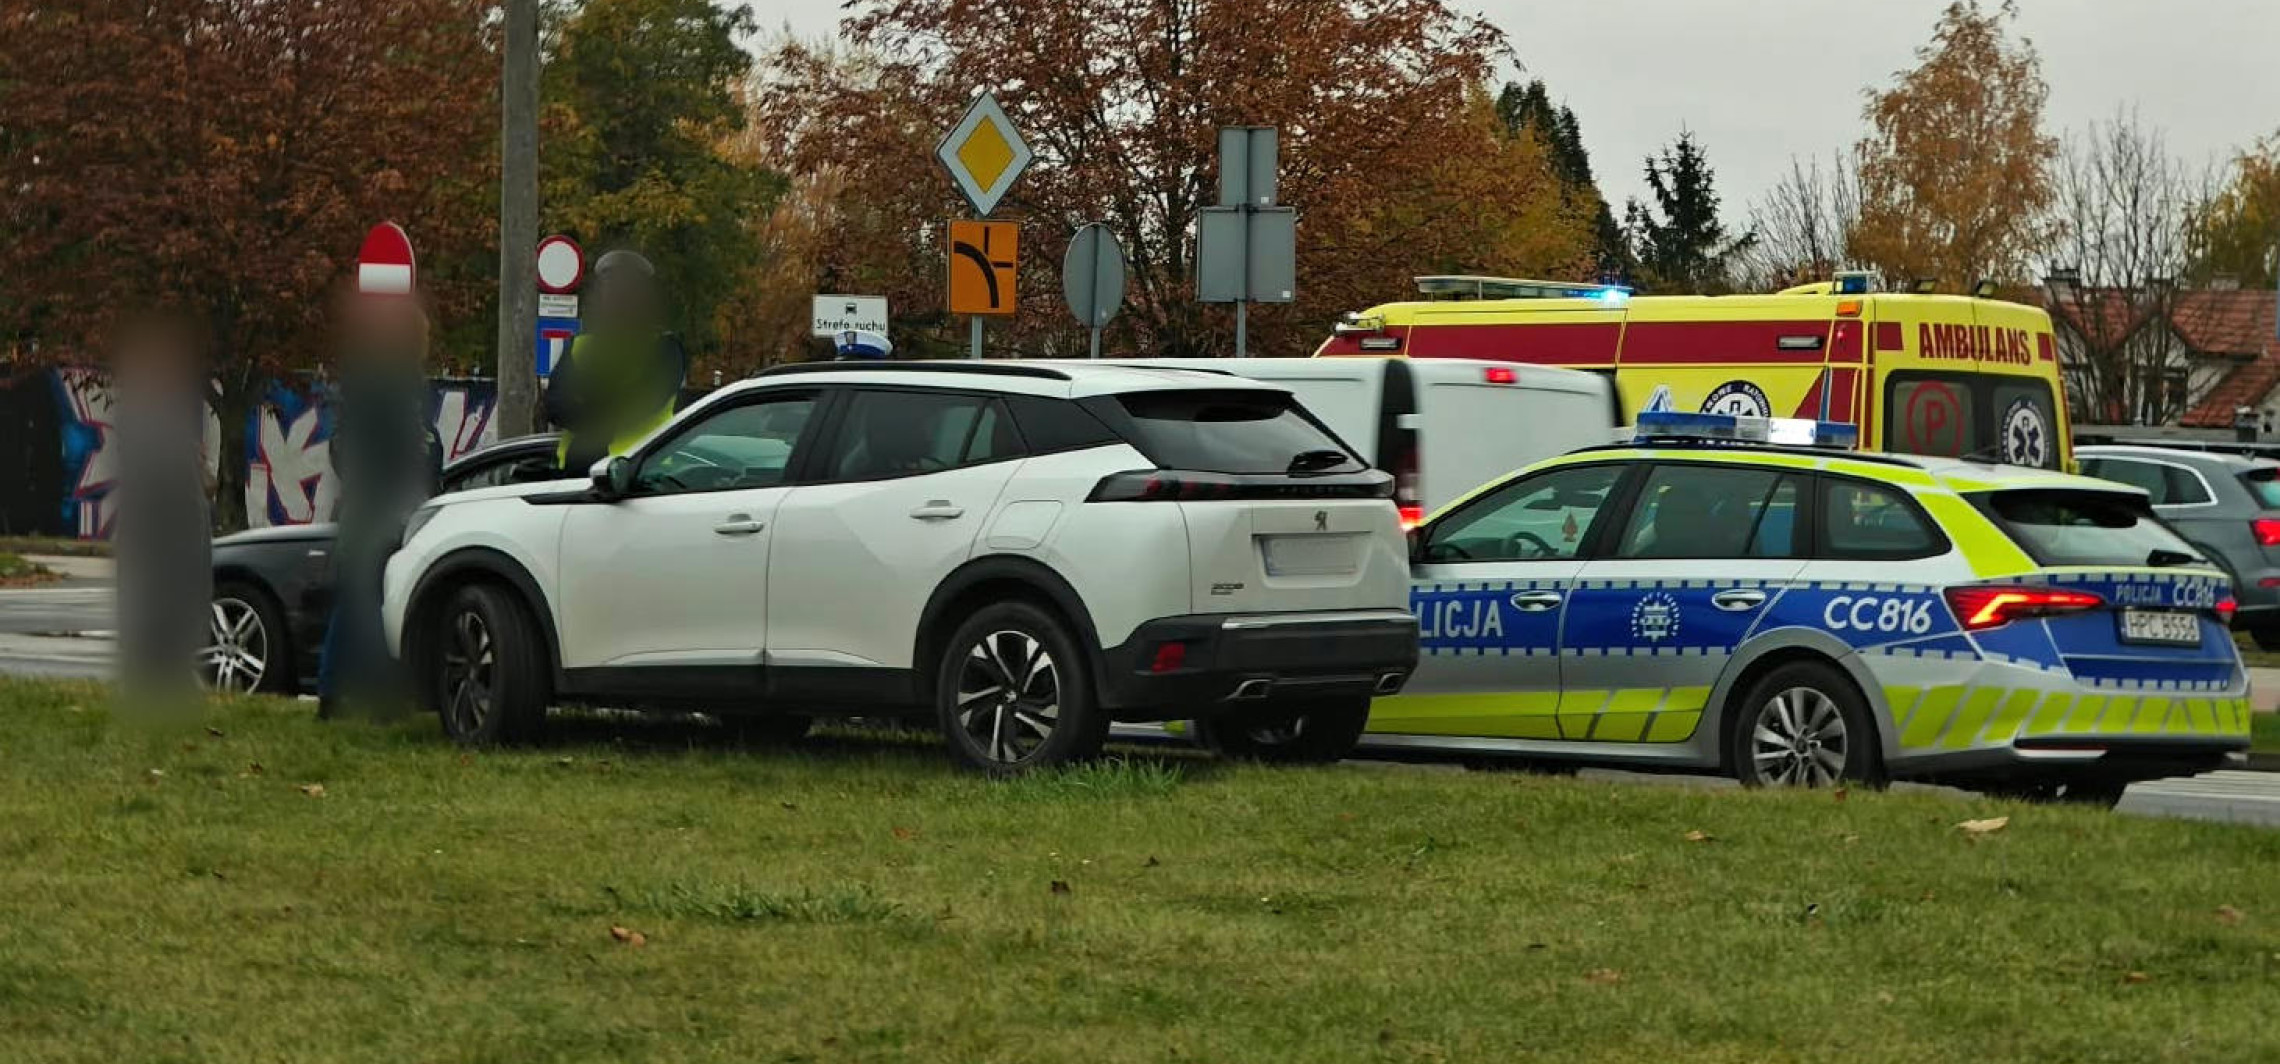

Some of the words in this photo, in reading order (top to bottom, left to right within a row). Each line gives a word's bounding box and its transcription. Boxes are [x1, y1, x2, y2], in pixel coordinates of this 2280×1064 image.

[854, 319, 886, 331] ruchu
[1919, 322, 2031, 366] AMBULANS
[2115, 584, 2161, 605] POLICJA
[2173, 581, 2216, 608] CC816
[1417, 600, 1504, 638] LICJA
[1824, 596, 1933, 635] CC816
[2128, 611, 2159, 637] HPC
